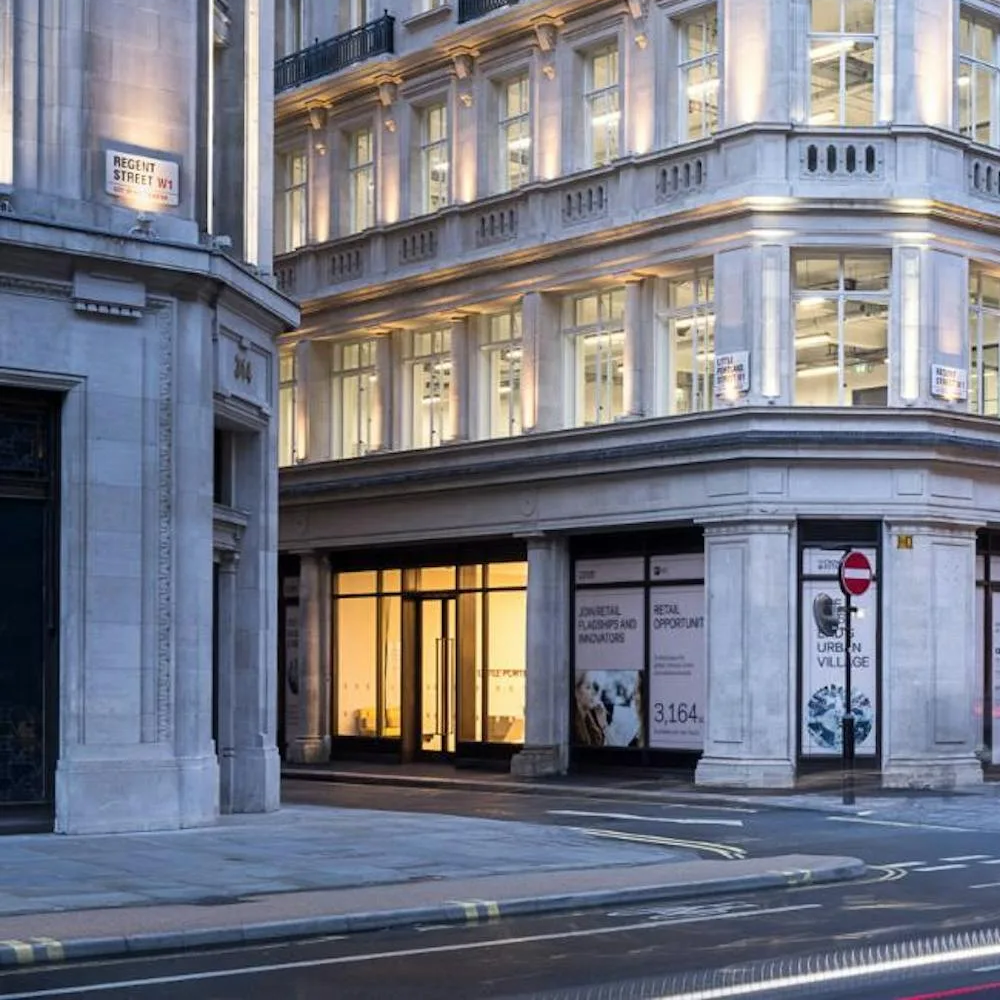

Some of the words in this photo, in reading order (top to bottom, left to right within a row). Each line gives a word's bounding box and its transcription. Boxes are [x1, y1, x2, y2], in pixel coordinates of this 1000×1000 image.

[113, 156, 155, 172] REGENT
[113, 169, 153, 186] STREET
[157, 177, 173, 190] W1
[653, 604, 679, 615] RETAIL
[578, 618, 619, 631] FLAGSHIPS
[620, 618, 637, 630] AND
[653, 616, 704, 629] OPPORTUNIT
[578, 632, 625, 644] INNOVATORS
[817, 642, 861, 653] URBN
[817, 656, 870, 668] VILLGE
[654, 702, 697, 726] 3,164
